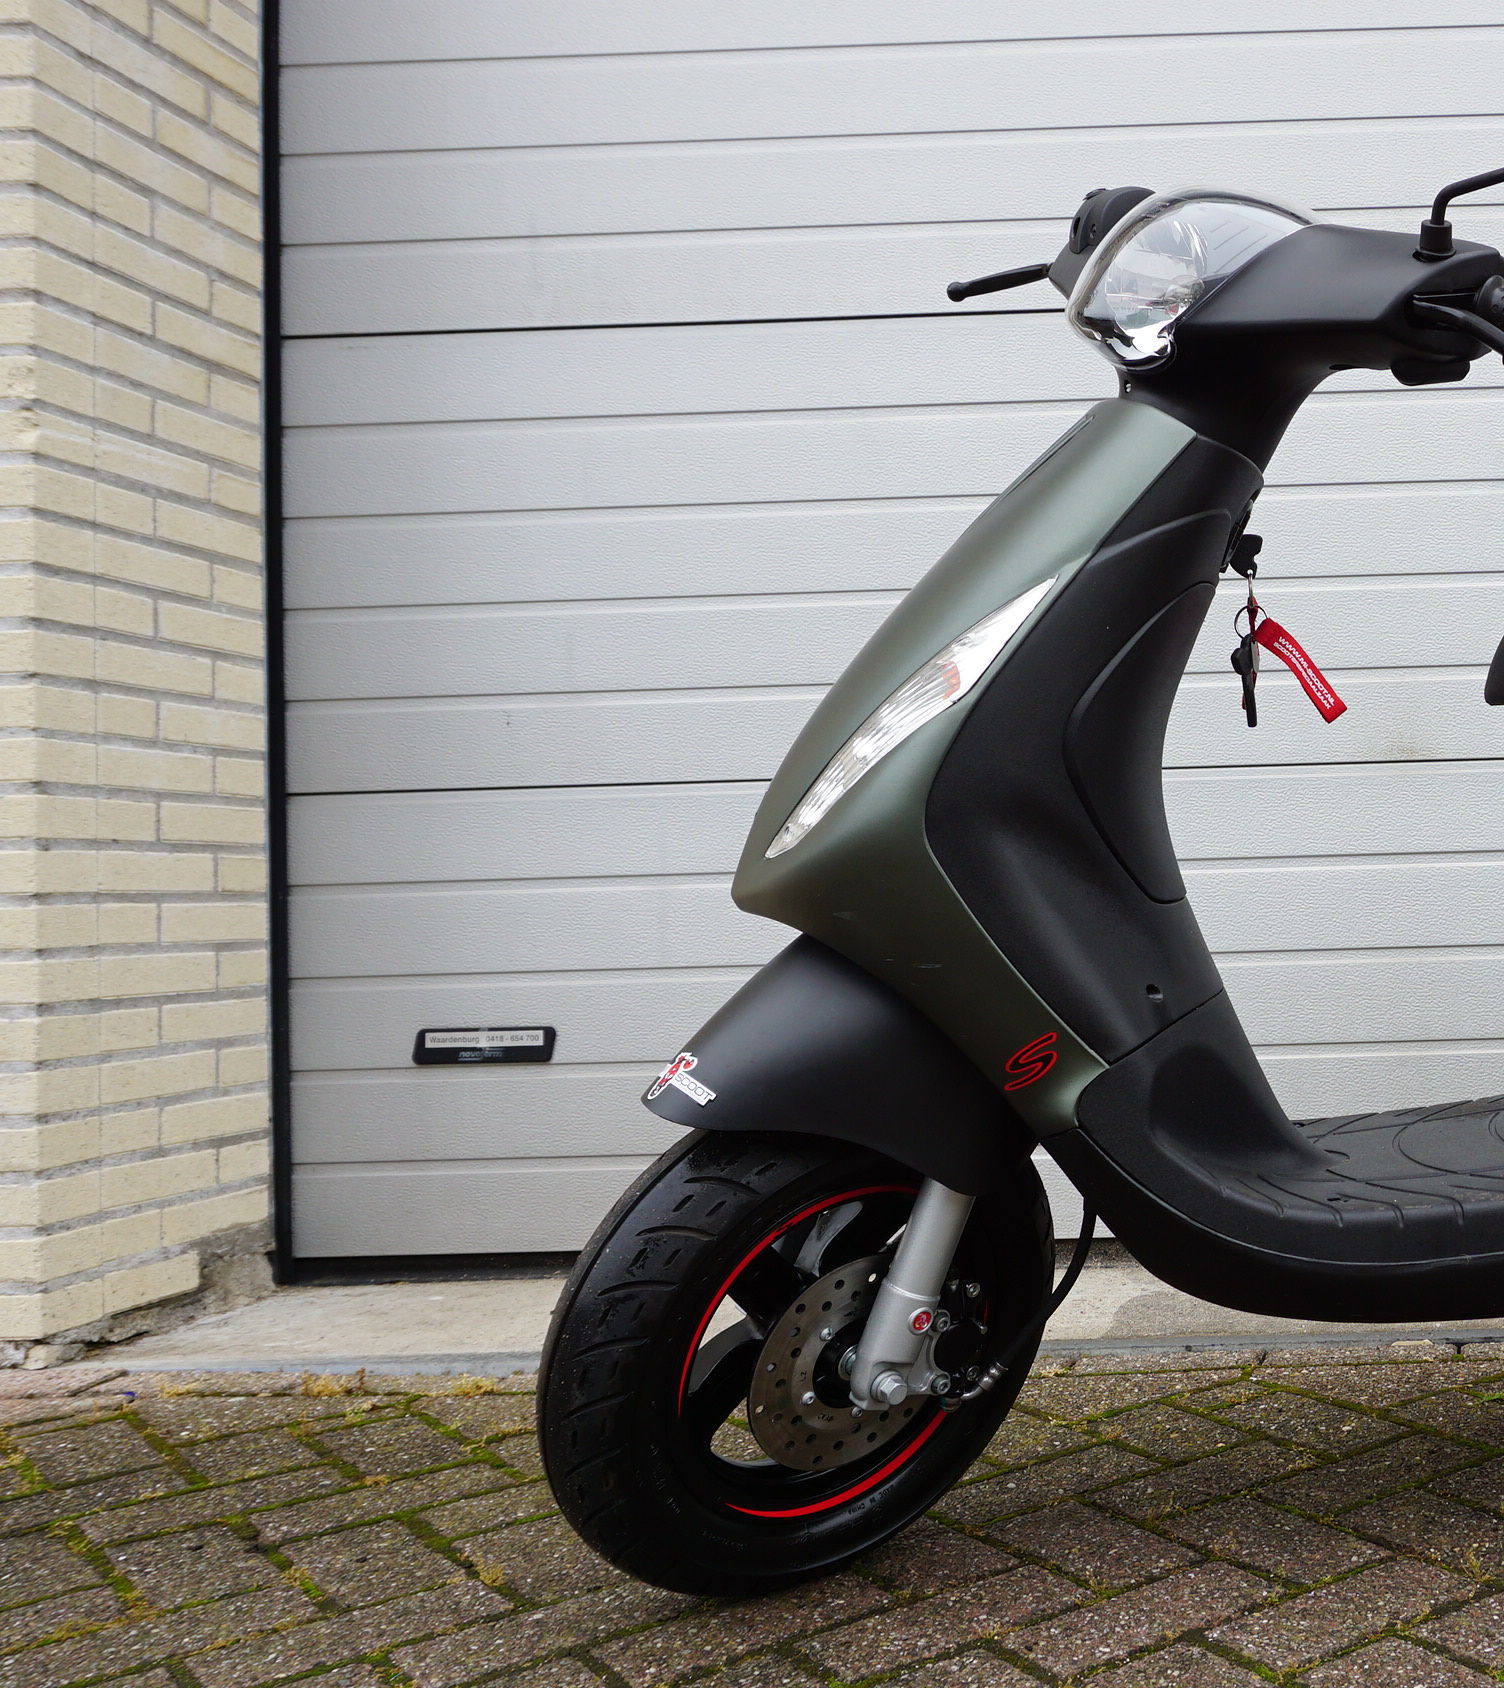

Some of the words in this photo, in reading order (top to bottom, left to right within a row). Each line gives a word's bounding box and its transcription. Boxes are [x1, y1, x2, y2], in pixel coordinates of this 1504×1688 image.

[429, 1036, 480, 1044] Waardenburg
[486, 1035, 504, 1043] 0418
[525, 1034, 540, 1042] 700
[1003, 1032, 1058, 1091] S
[675, 1072, 713, 1101] SCOOT
